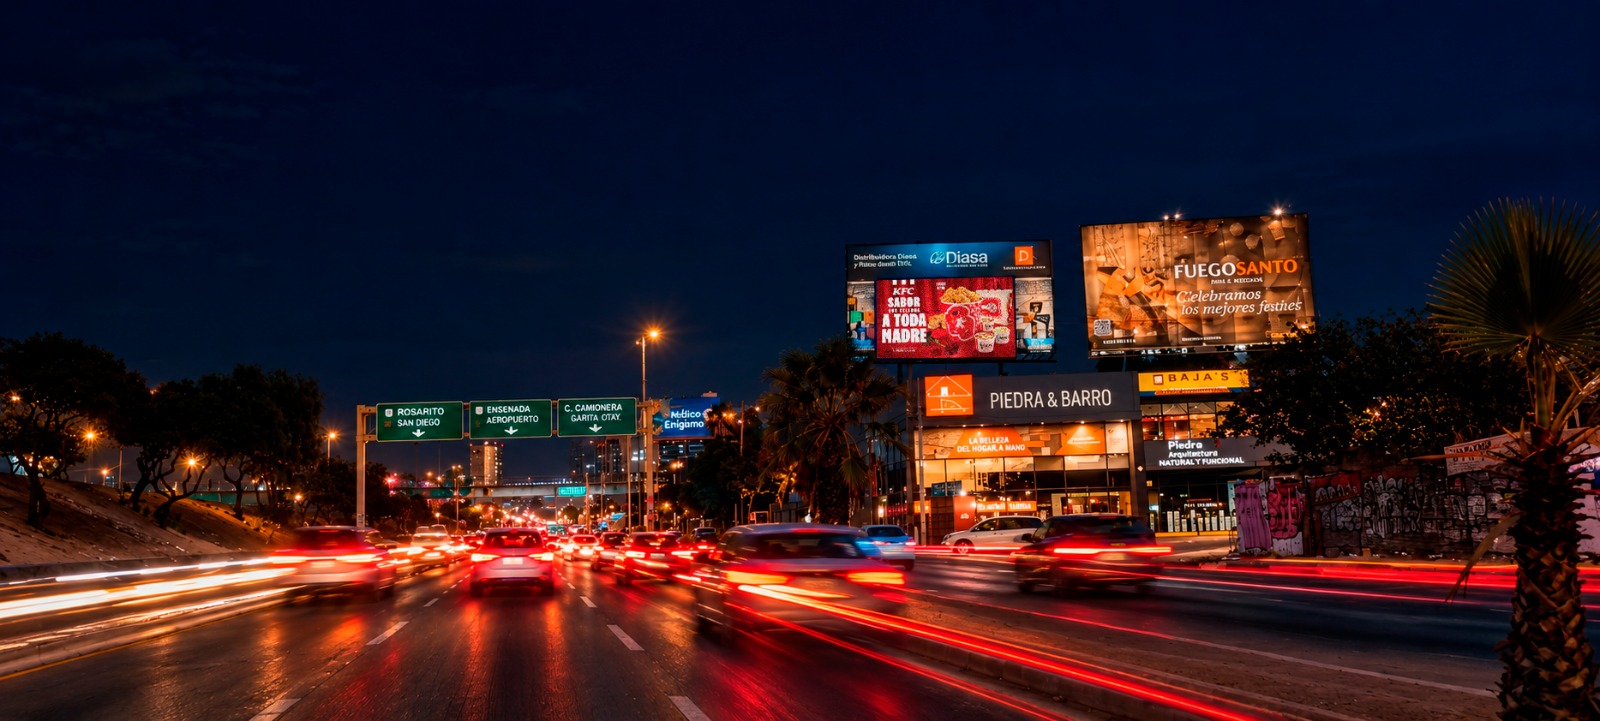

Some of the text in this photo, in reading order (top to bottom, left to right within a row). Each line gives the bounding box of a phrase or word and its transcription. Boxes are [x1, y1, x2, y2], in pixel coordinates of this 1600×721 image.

[946, 251, 988, 264] Diasa
[1174, 259, 1298, 279] FUEGOSANTO
[892, 287, 915, 296] KFC
[887, 296, 921, 308] SABOR
[1181, 304, 1199, 315] los
[1203, 302, 1255, 317] mejores
[882, 312, 927, 328] A TODA
[881, 328, 928, 344] MADRE
[1168, 372, 1229, 382] BAJA'S
[990, 389, 1112, 409] PIEDRA & BARRO
[397, 407, 445, 416] ROSARITO
[487, 405, 531, 414] ENSENADA
[564, 403, 623, 413] C. CAMIONERA
[397, 418, 440, 427] SAN DIEGO
[486, 415, 539, 424] AEROPUERTO
[571, 414, 598, 422] GARITA
[968, 436, 1010, 445] LA BELLEZA
[1168, 440, 1203, 450] Piedra
[957, 445, 970, 453] DEL
[1158, 458, 1195, 467] NATURAL
[1202, 457, 1245, 465] FUNCIONAL
